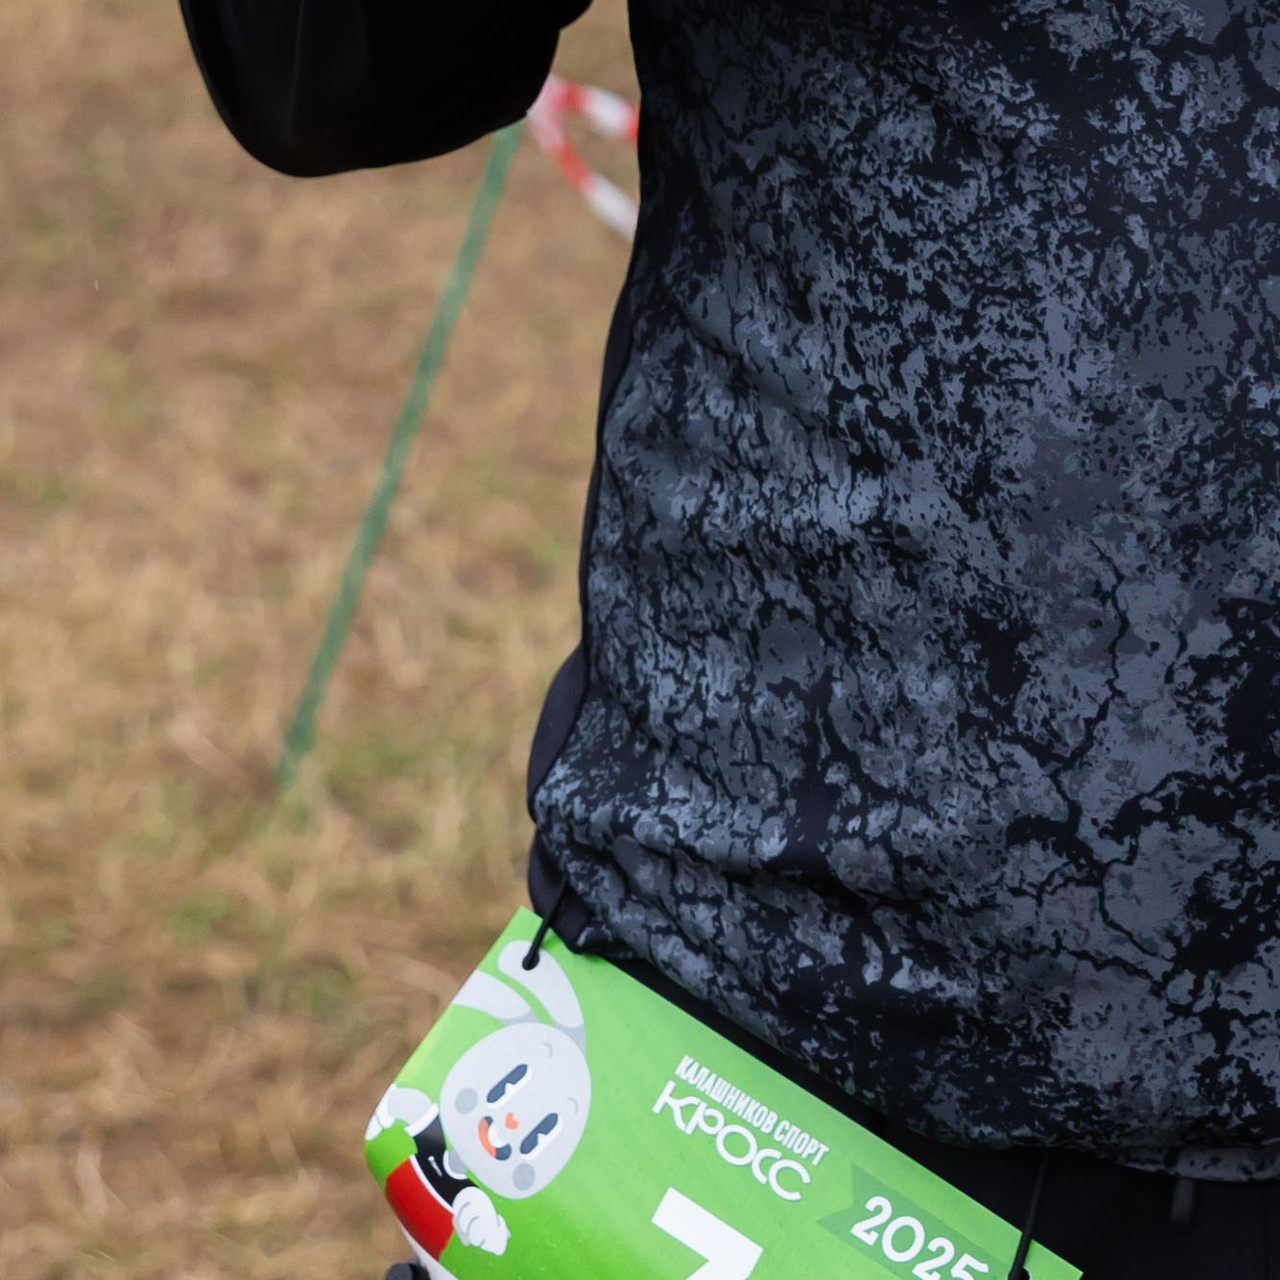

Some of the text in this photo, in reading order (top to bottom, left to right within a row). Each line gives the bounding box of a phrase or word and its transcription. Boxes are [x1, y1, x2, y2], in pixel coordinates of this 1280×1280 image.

[651, 1080, 811, 1202] КРОСС
[674, 1055, 829, 1166] КАЛАШНИКОВ СПОРТ
[850, 1195, 990, 1280] 2025
